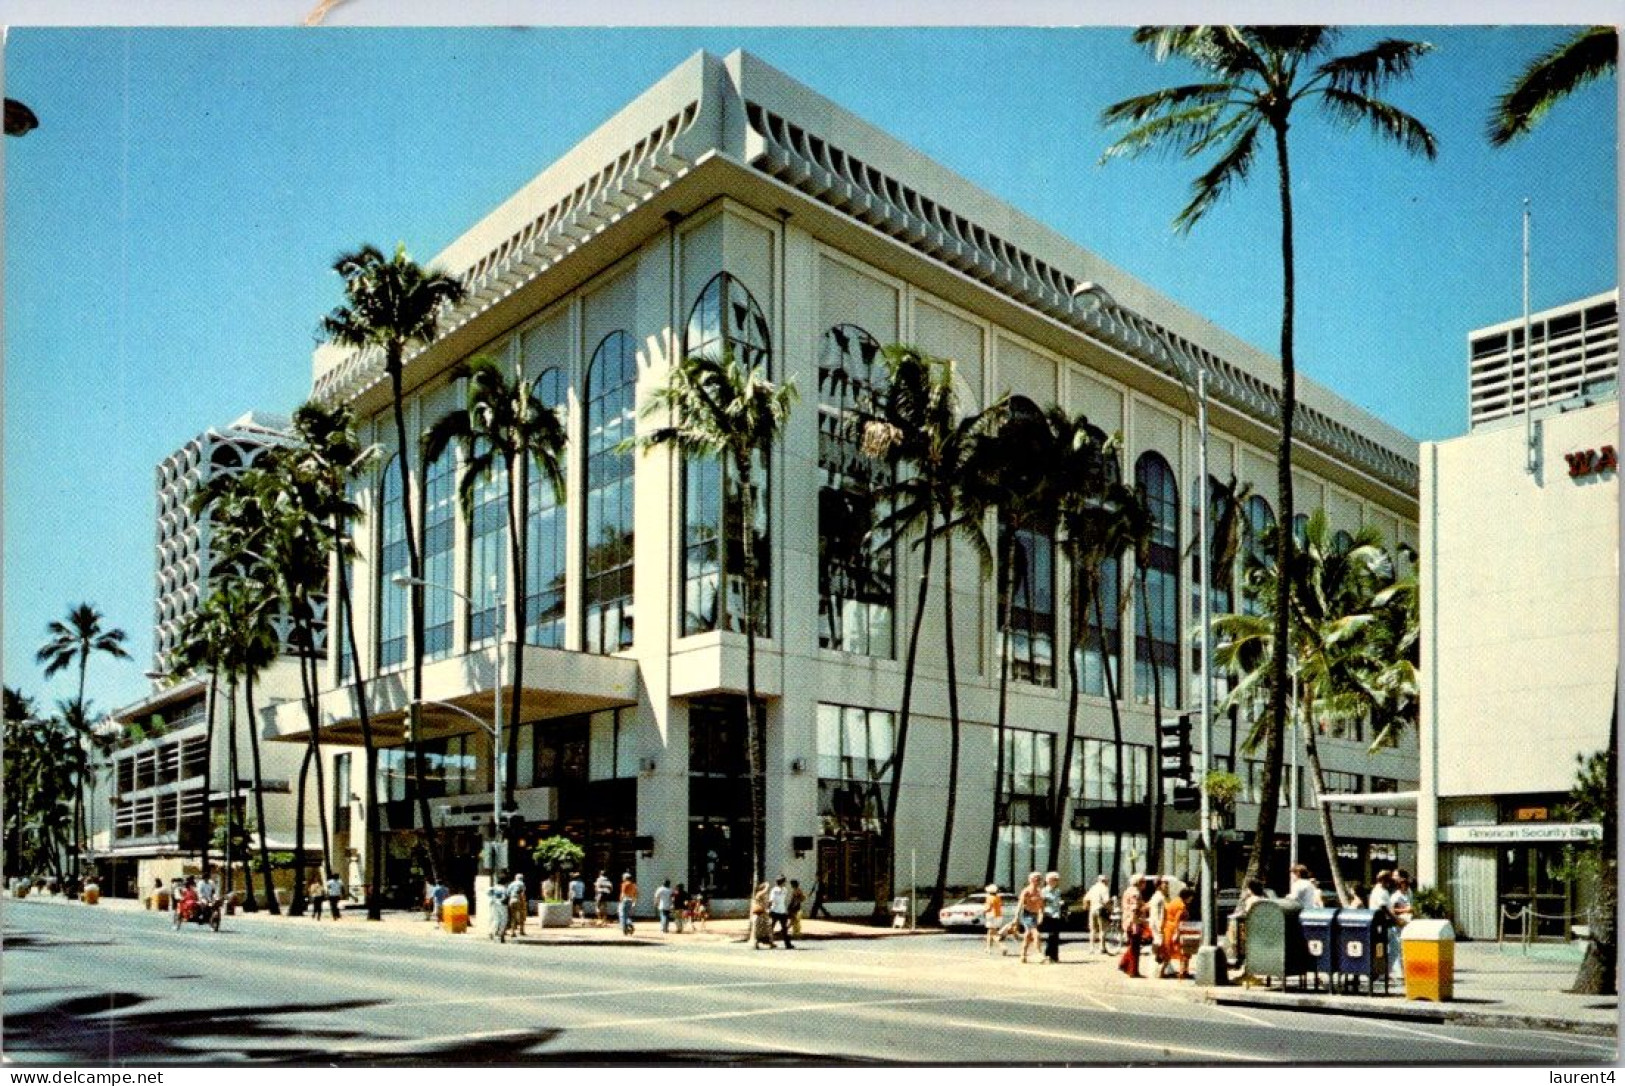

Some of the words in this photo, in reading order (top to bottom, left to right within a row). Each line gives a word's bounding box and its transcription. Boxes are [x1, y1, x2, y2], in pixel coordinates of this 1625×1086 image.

[1469, 828, 1519, 838] American
[1521, 827, 1568, 840] Security
[1570, 827, 1600, 838] Bank
